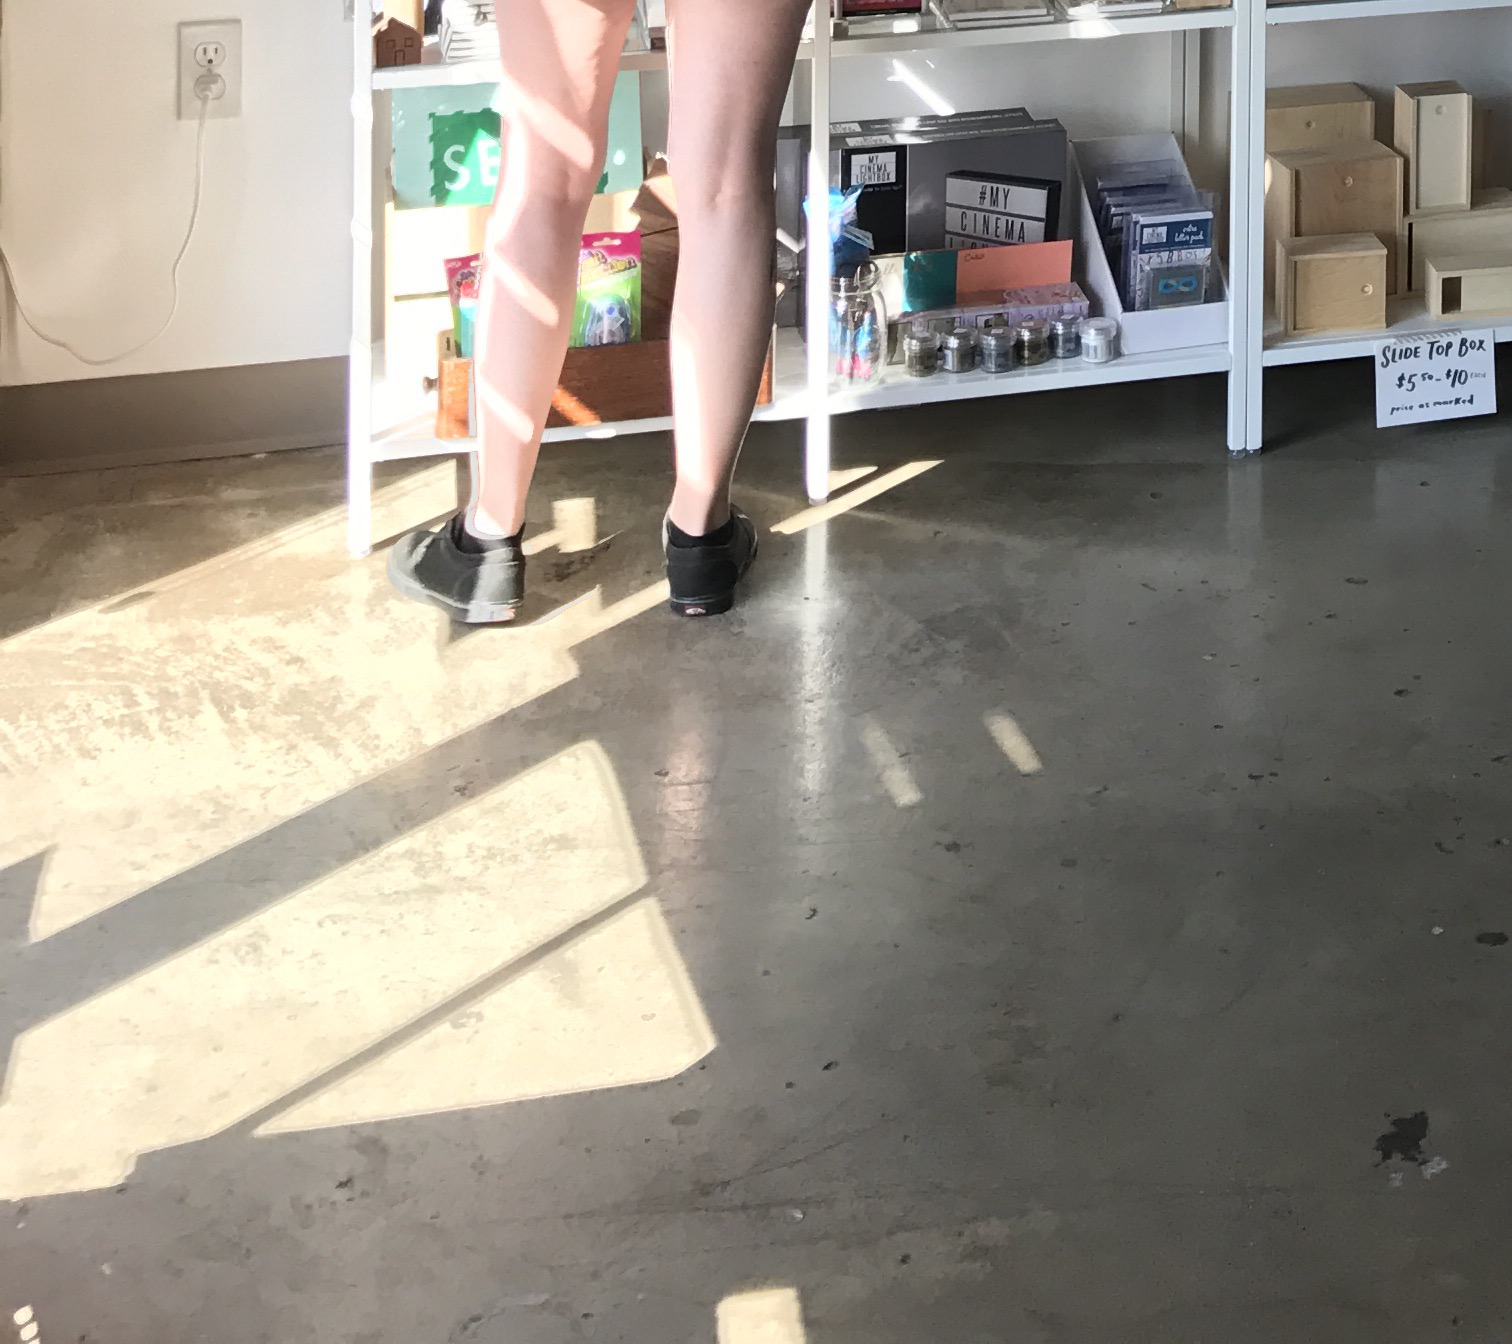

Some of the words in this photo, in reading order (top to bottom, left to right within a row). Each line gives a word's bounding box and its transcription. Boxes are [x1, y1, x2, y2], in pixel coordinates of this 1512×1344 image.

[859, 163, 888, 173] CINEMA
[868, 154, 880, 164] MY
[979, 184, 1011, 209] #MY
[960, 211, 1026, 242] CINEMA
[1427, 340, 1453, 360] TOP
[1445, 369, 1468, 388] $10
[1390, 405, 1413, 415] price
